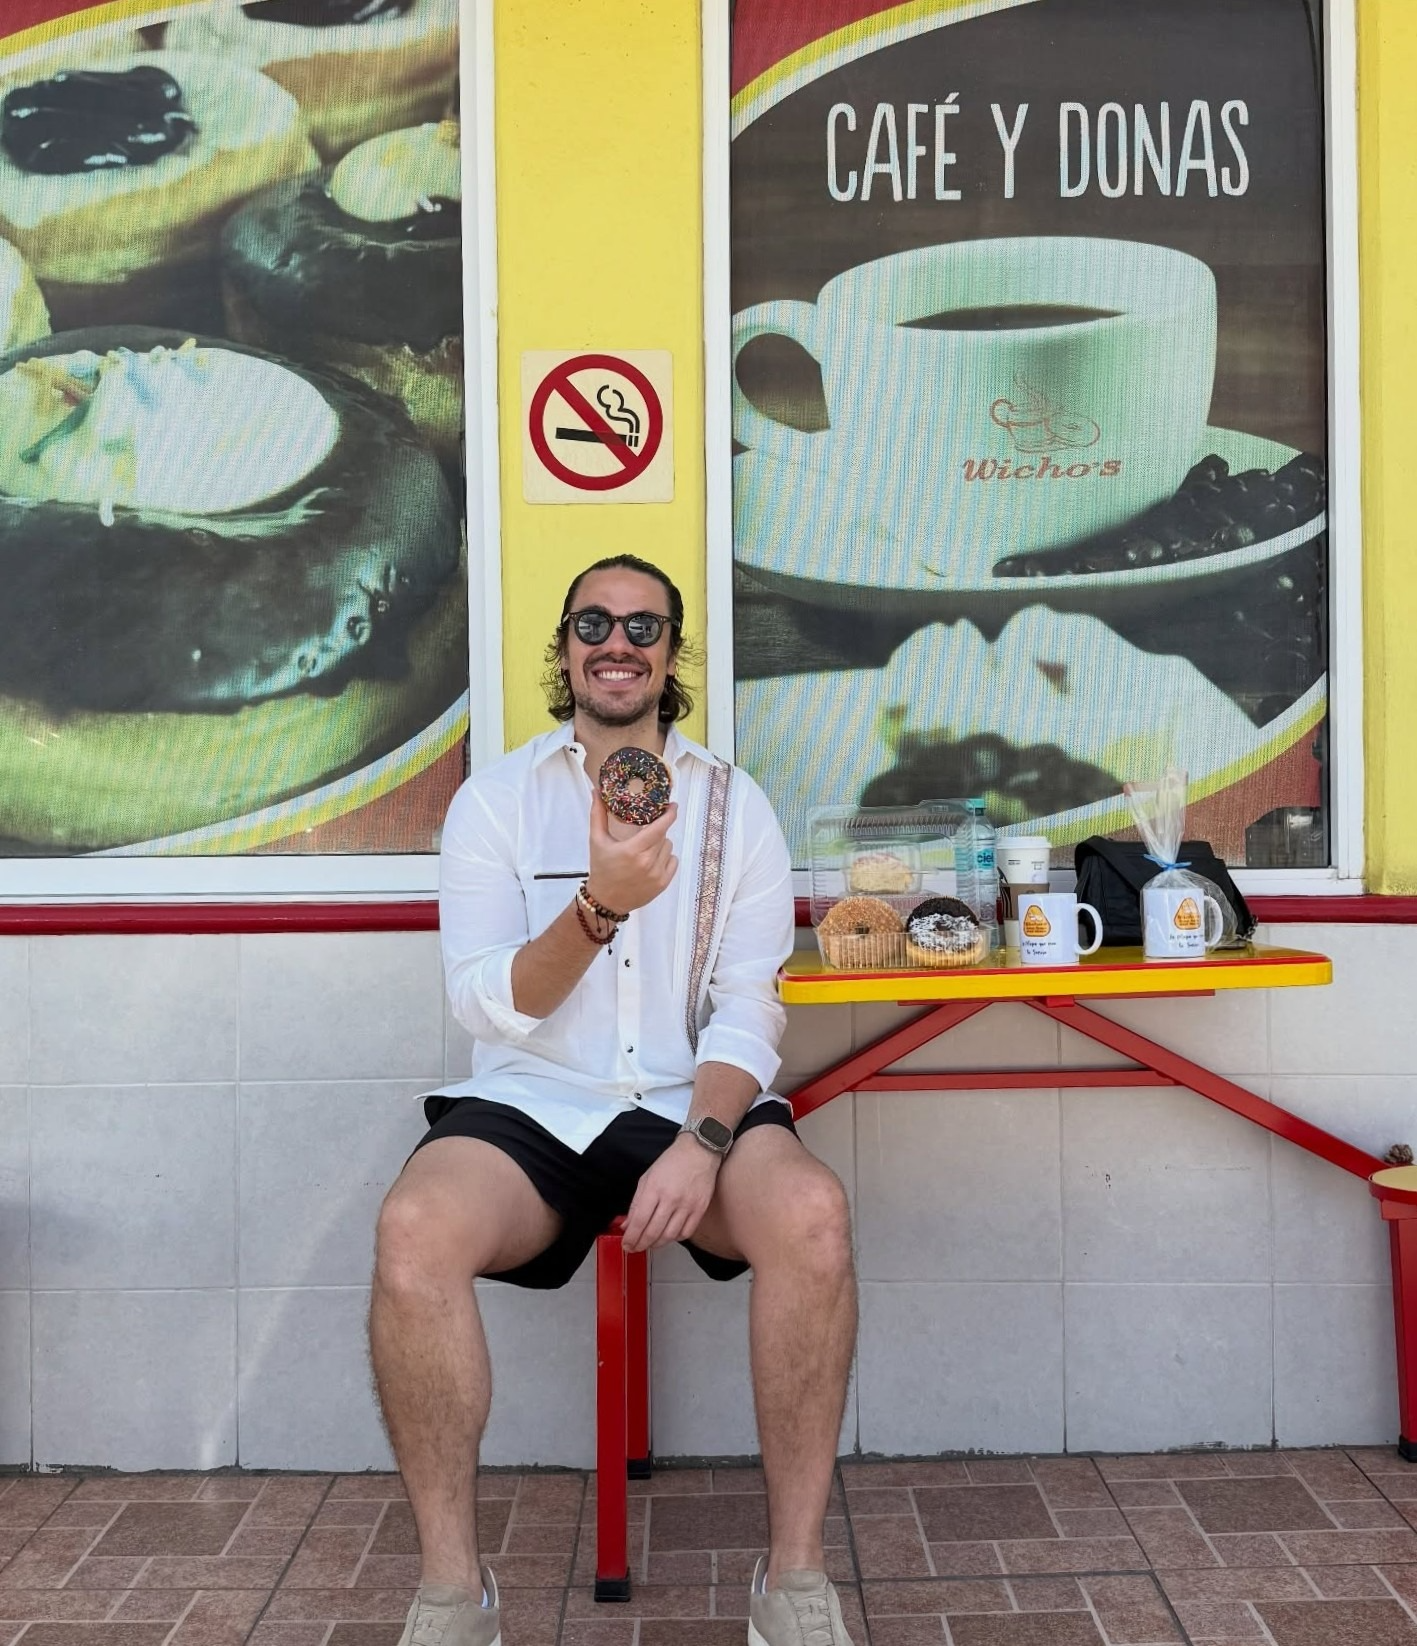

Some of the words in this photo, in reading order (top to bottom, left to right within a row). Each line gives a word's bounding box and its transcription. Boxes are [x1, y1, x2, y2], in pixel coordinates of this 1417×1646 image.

[827, 92, 962, 202] CAFÉ
[990, 103, 1029, 199] Y
[1059, 100, 1250, 199] DONAS
[963, 456, 1121, 482] Wicho's
[977, 852, 994, 863] ciel
